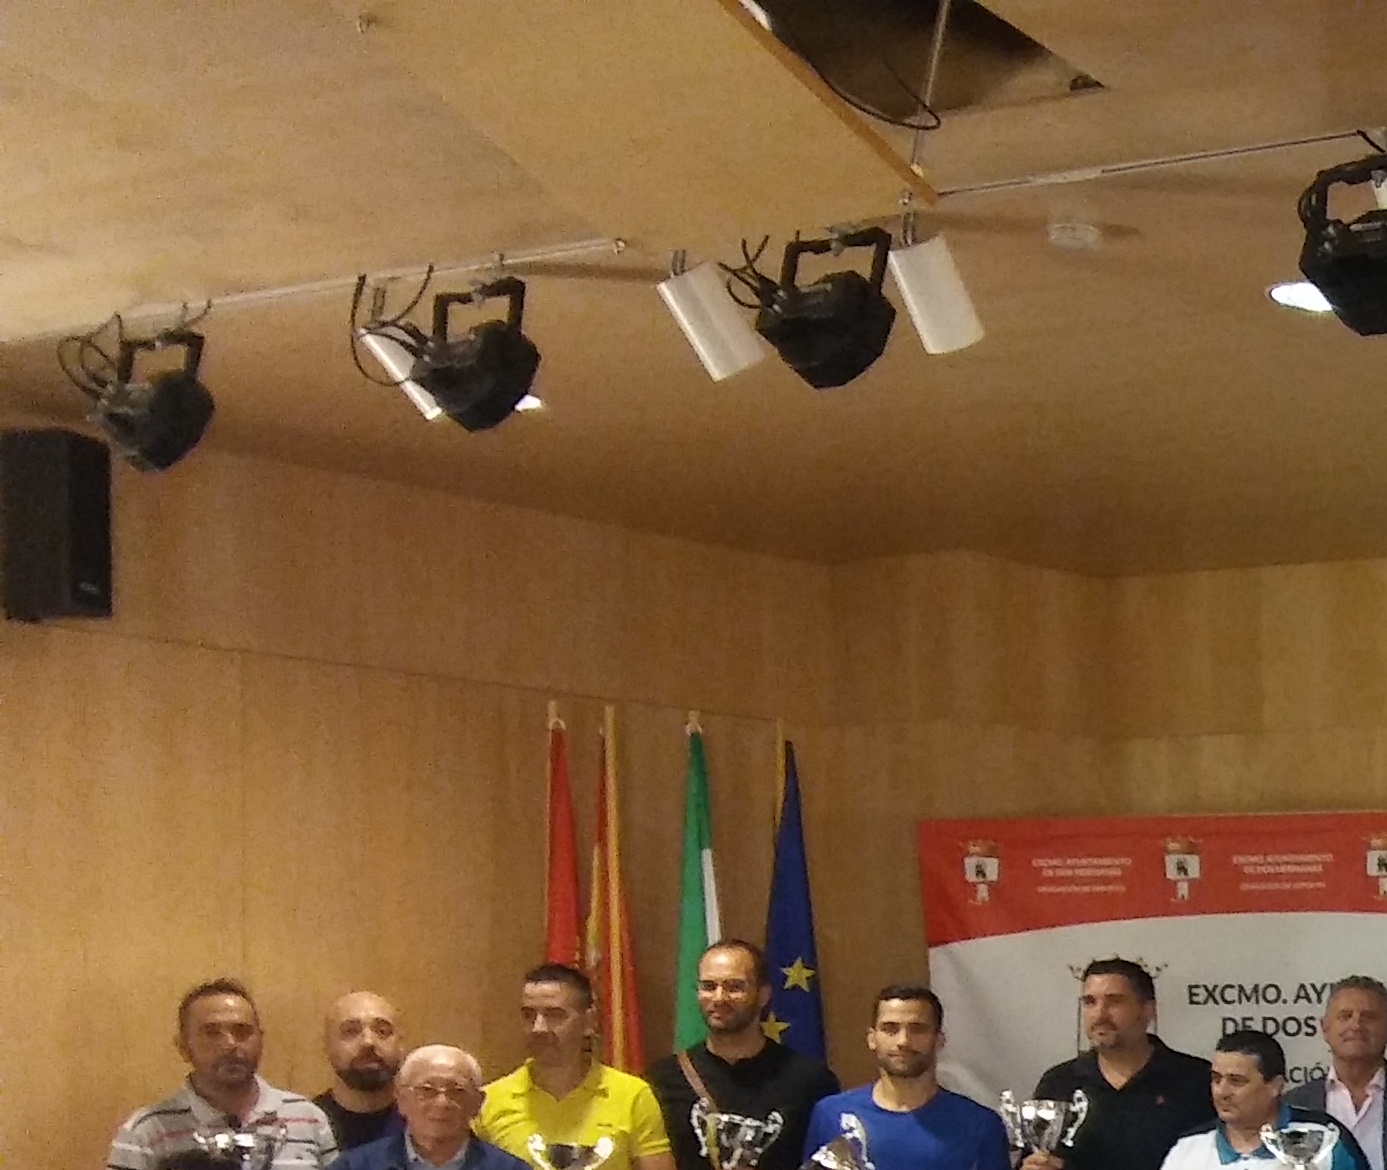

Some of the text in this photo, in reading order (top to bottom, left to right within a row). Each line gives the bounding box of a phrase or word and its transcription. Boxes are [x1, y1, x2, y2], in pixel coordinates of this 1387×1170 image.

[1187, 983, 1288, 1006] EXCMO.
[1221, 1015, 1318, 1037] DE DOS
